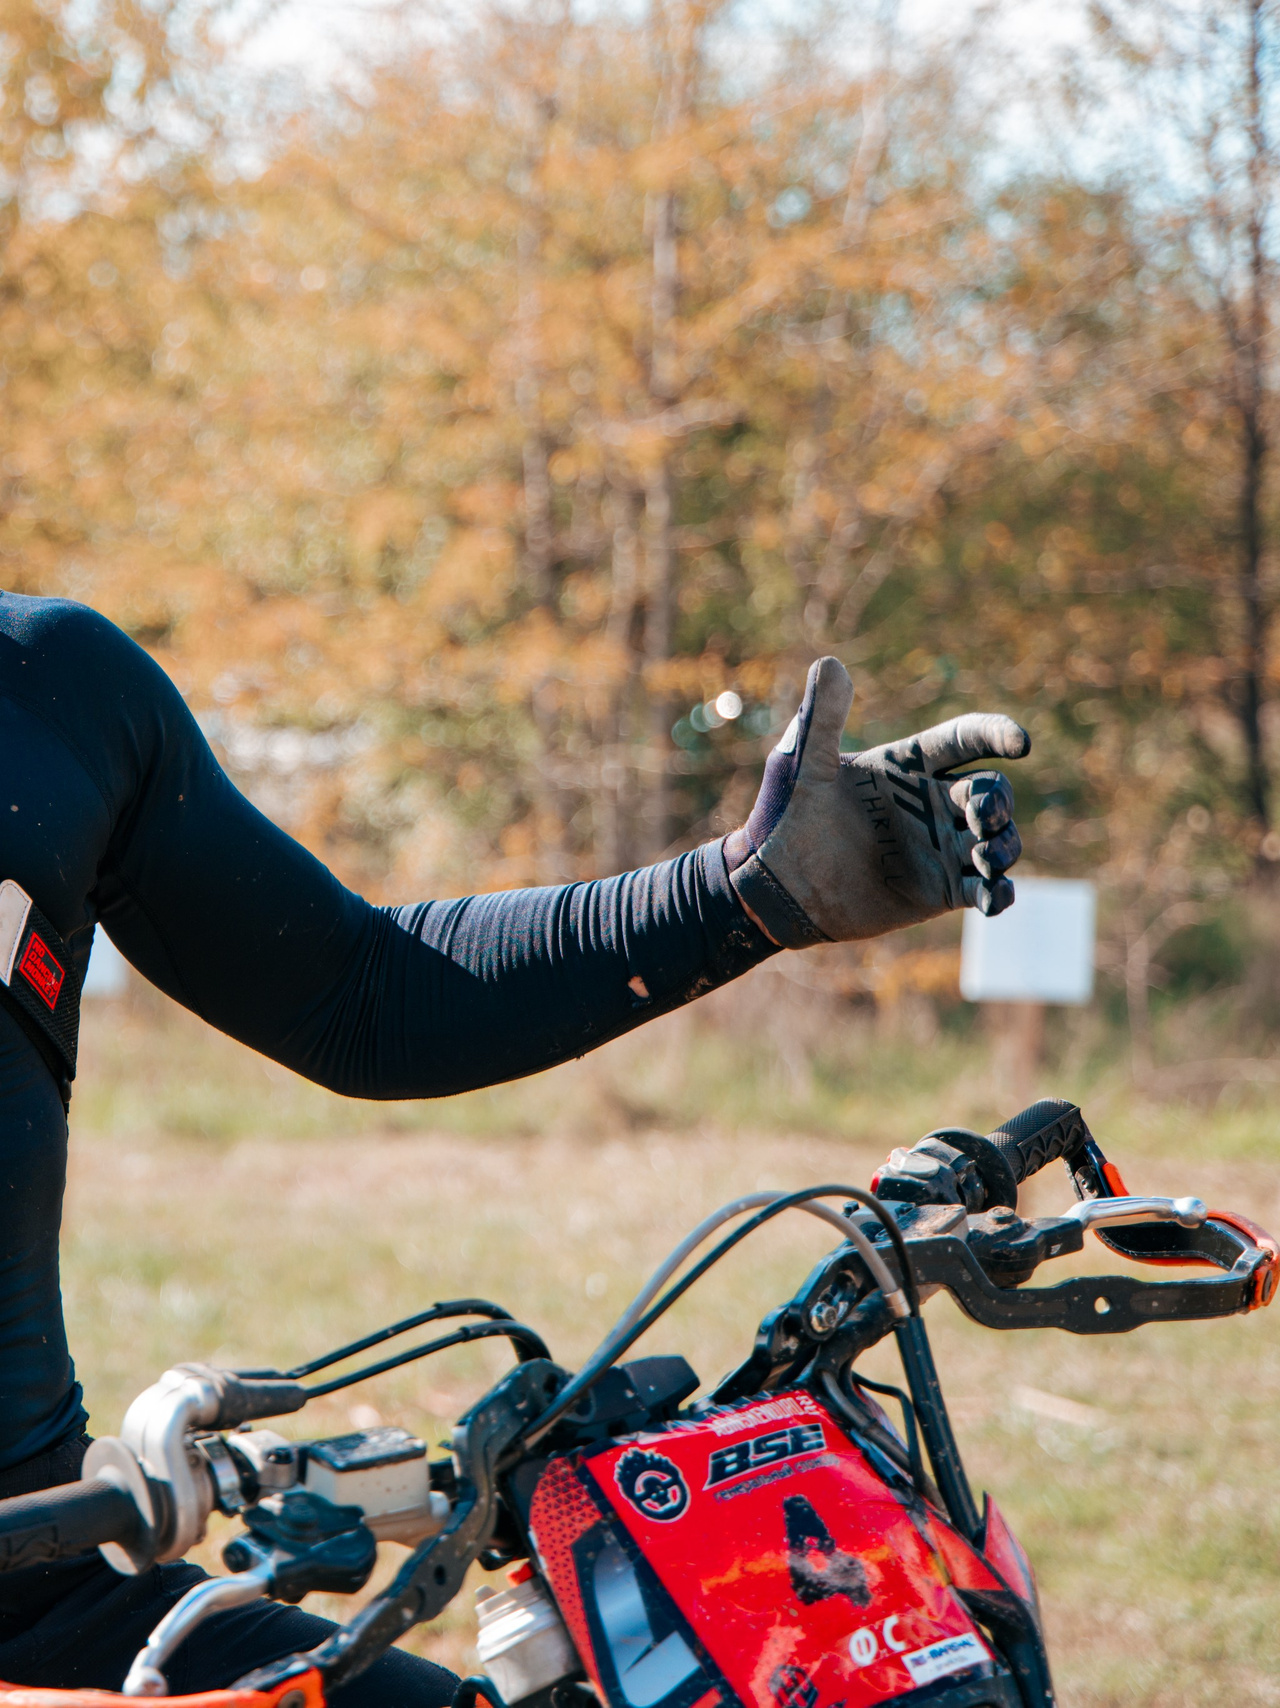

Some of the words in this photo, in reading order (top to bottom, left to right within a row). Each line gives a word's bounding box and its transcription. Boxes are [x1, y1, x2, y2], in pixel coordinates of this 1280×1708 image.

[855, 771, 904, 887] THRILL
[32, 941, 46, 958] NO
[24, 961, 56, 999] MONKEY
[703, 1423, 827, 1491] BSE
